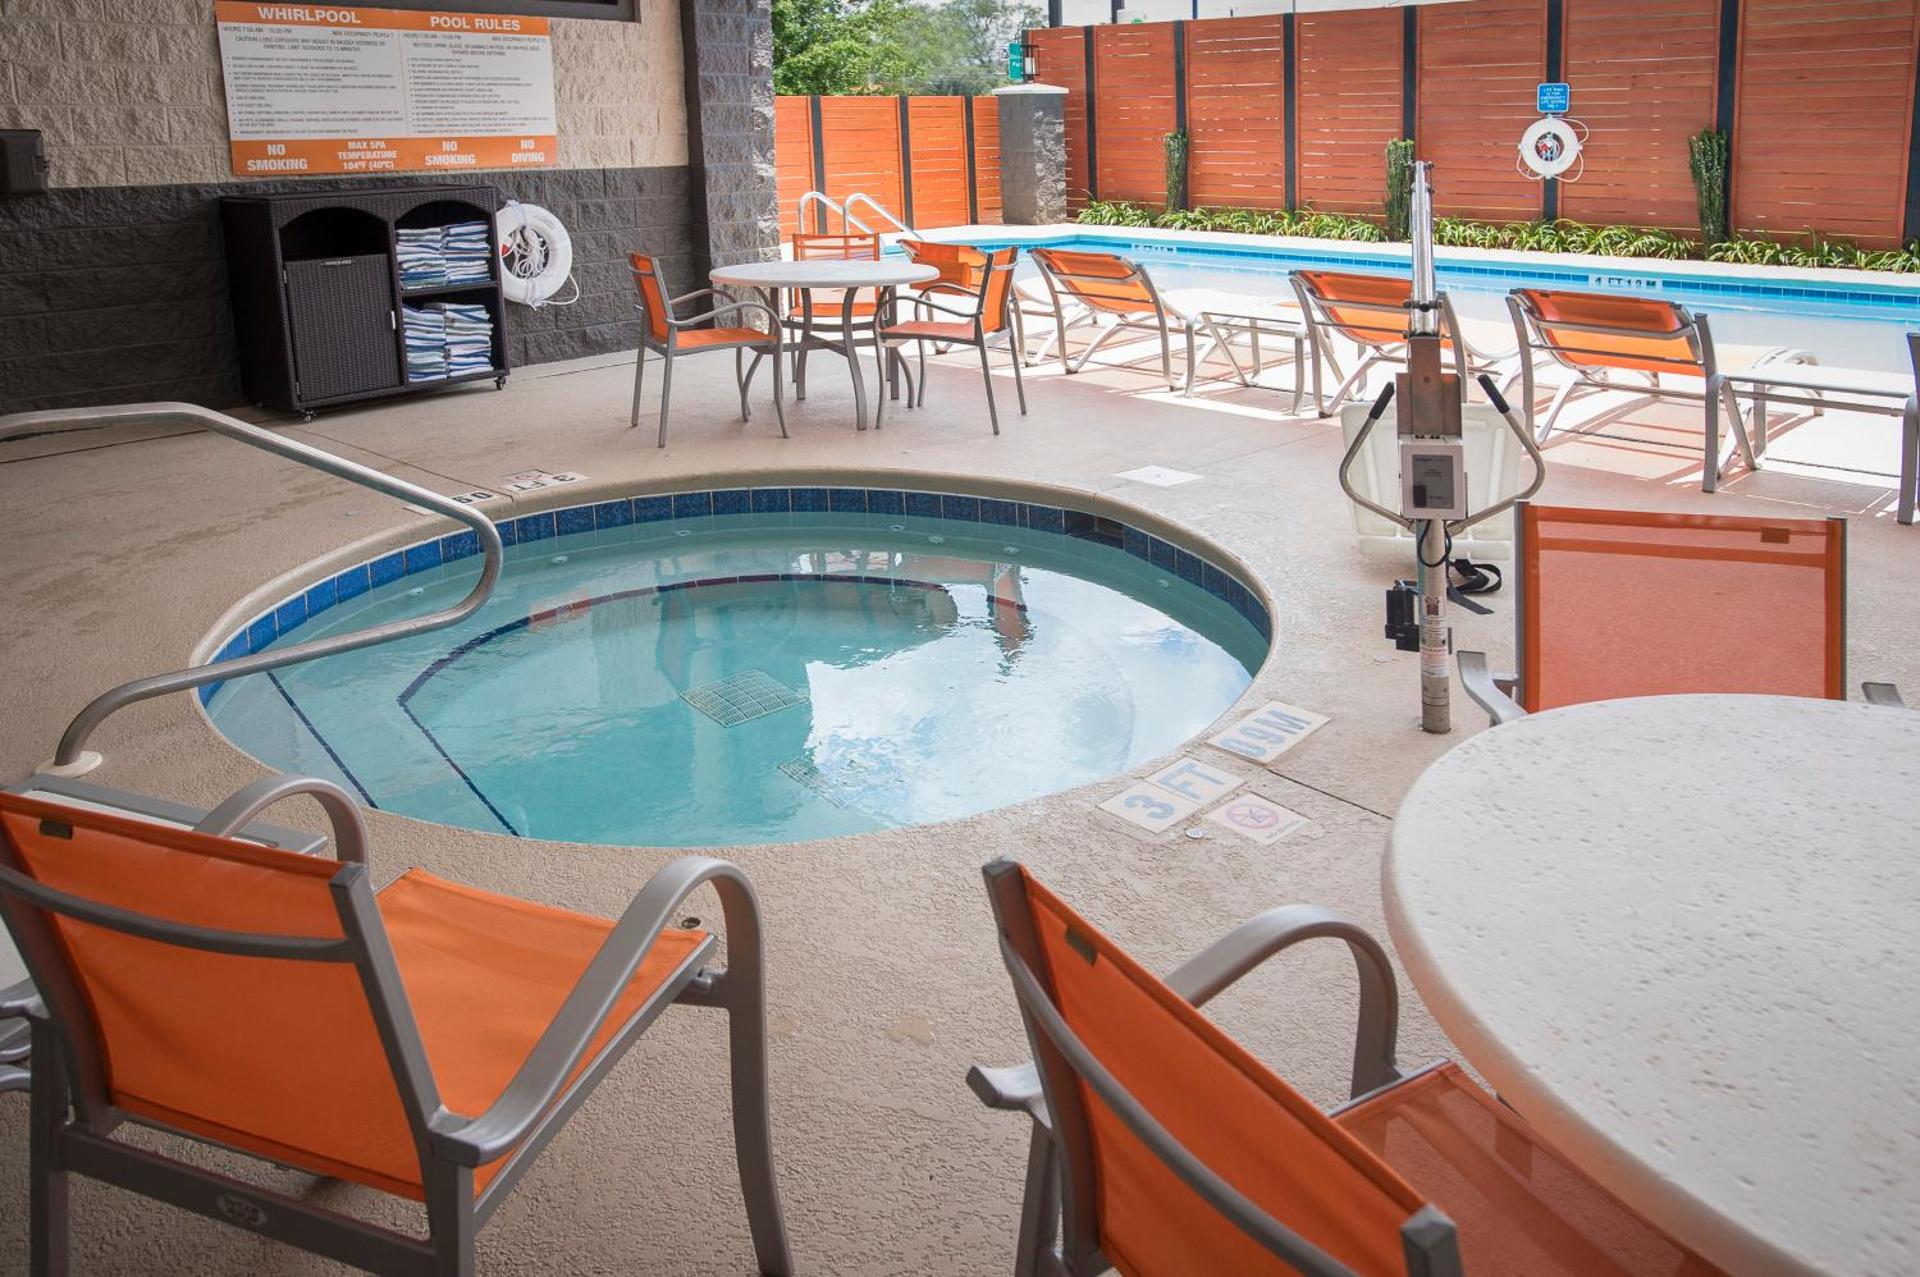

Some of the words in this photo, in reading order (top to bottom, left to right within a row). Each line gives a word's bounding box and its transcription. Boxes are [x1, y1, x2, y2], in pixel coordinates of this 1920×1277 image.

[257, 6, 362, 24] WHIRLPOOL
[430, 16, 471, 29] POOL
[475, 18, 521, 31] RULES
[267, 143, 286, 156] NO
[347, 140, 367, 149] MAX
[370, 140, 386, 149] SPA
[442, 140, 458, 152] NO
[520, 139, 535, 150] NO
[424, 153, 476, 166] SMOKING
[511, 151, 545, 163] DIVING
[247, 158, 308, 171] SMOKING
[1124, 794, 1175, 820] 3
[1158, 762, 1225, 800] FT
